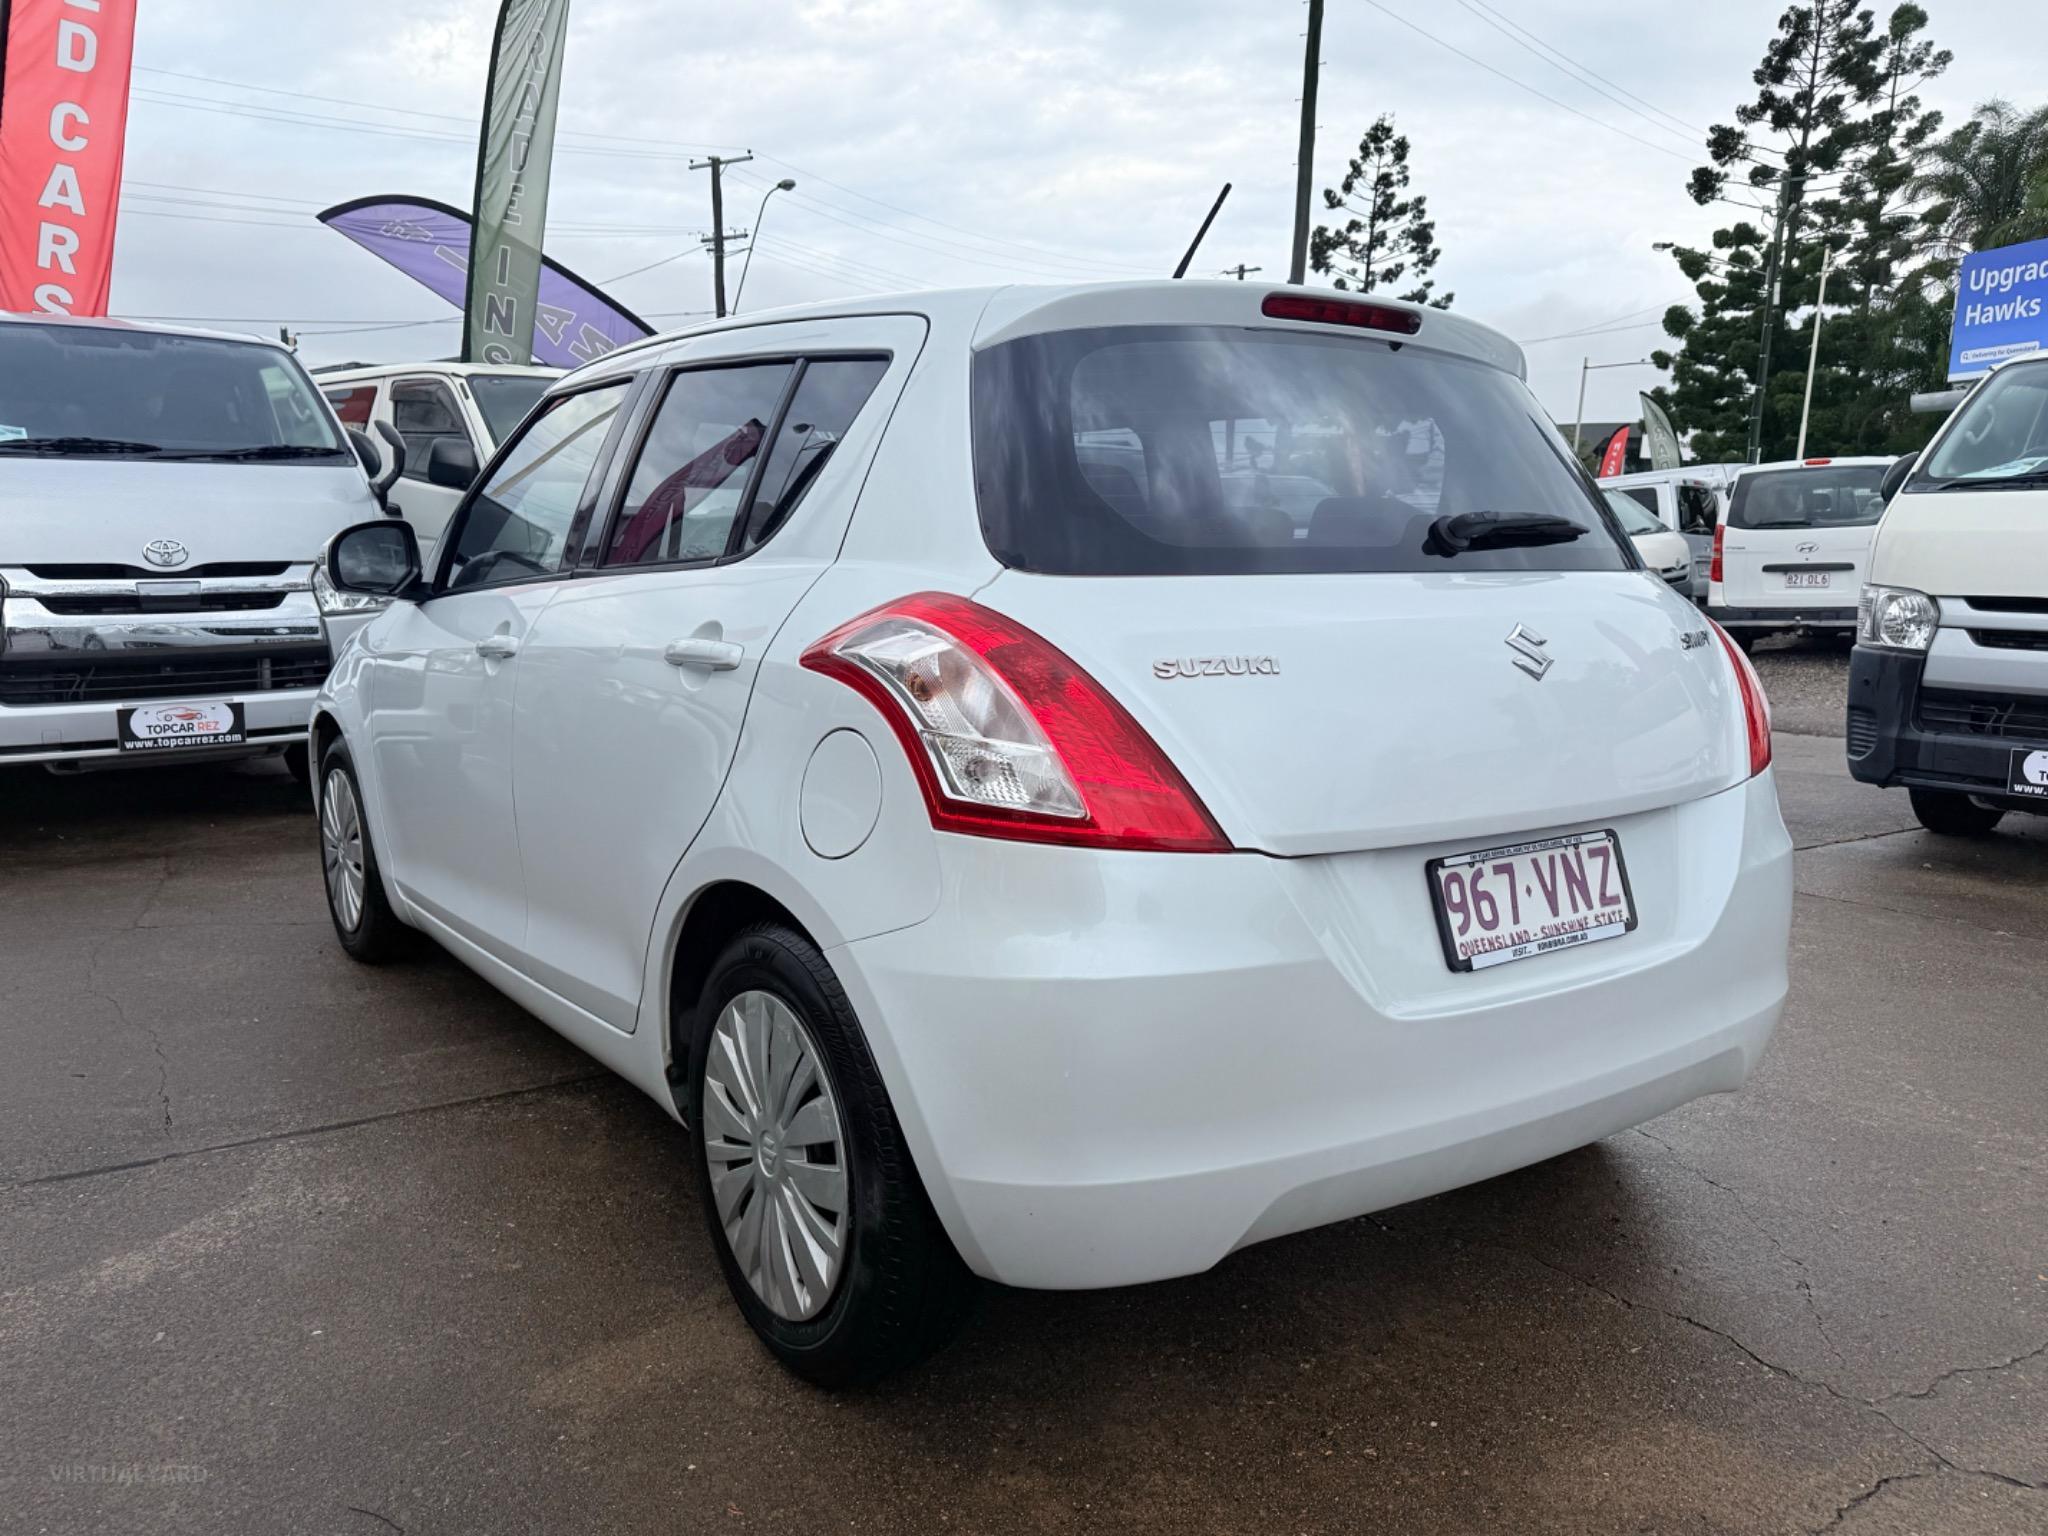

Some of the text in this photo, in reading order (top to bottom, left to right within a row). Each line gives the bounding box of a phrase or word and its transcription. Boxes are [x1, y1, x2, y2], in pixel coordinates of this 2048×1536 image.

[55, 0, 100, 73] D
[1964, 295, 2042, 327] Hawks
[1152, 655, 1280, 680] SUZUKI
[124, 733, 242, 750] www.topcarrez.com
[146, 721, 220, 735] TOPCAR REZ
[1458, 929, 1531, 957] QUEENSLAND
[1540, 916, 1589, 940] SUNSHINE
[1594, 909, 1624, 925] STATE
